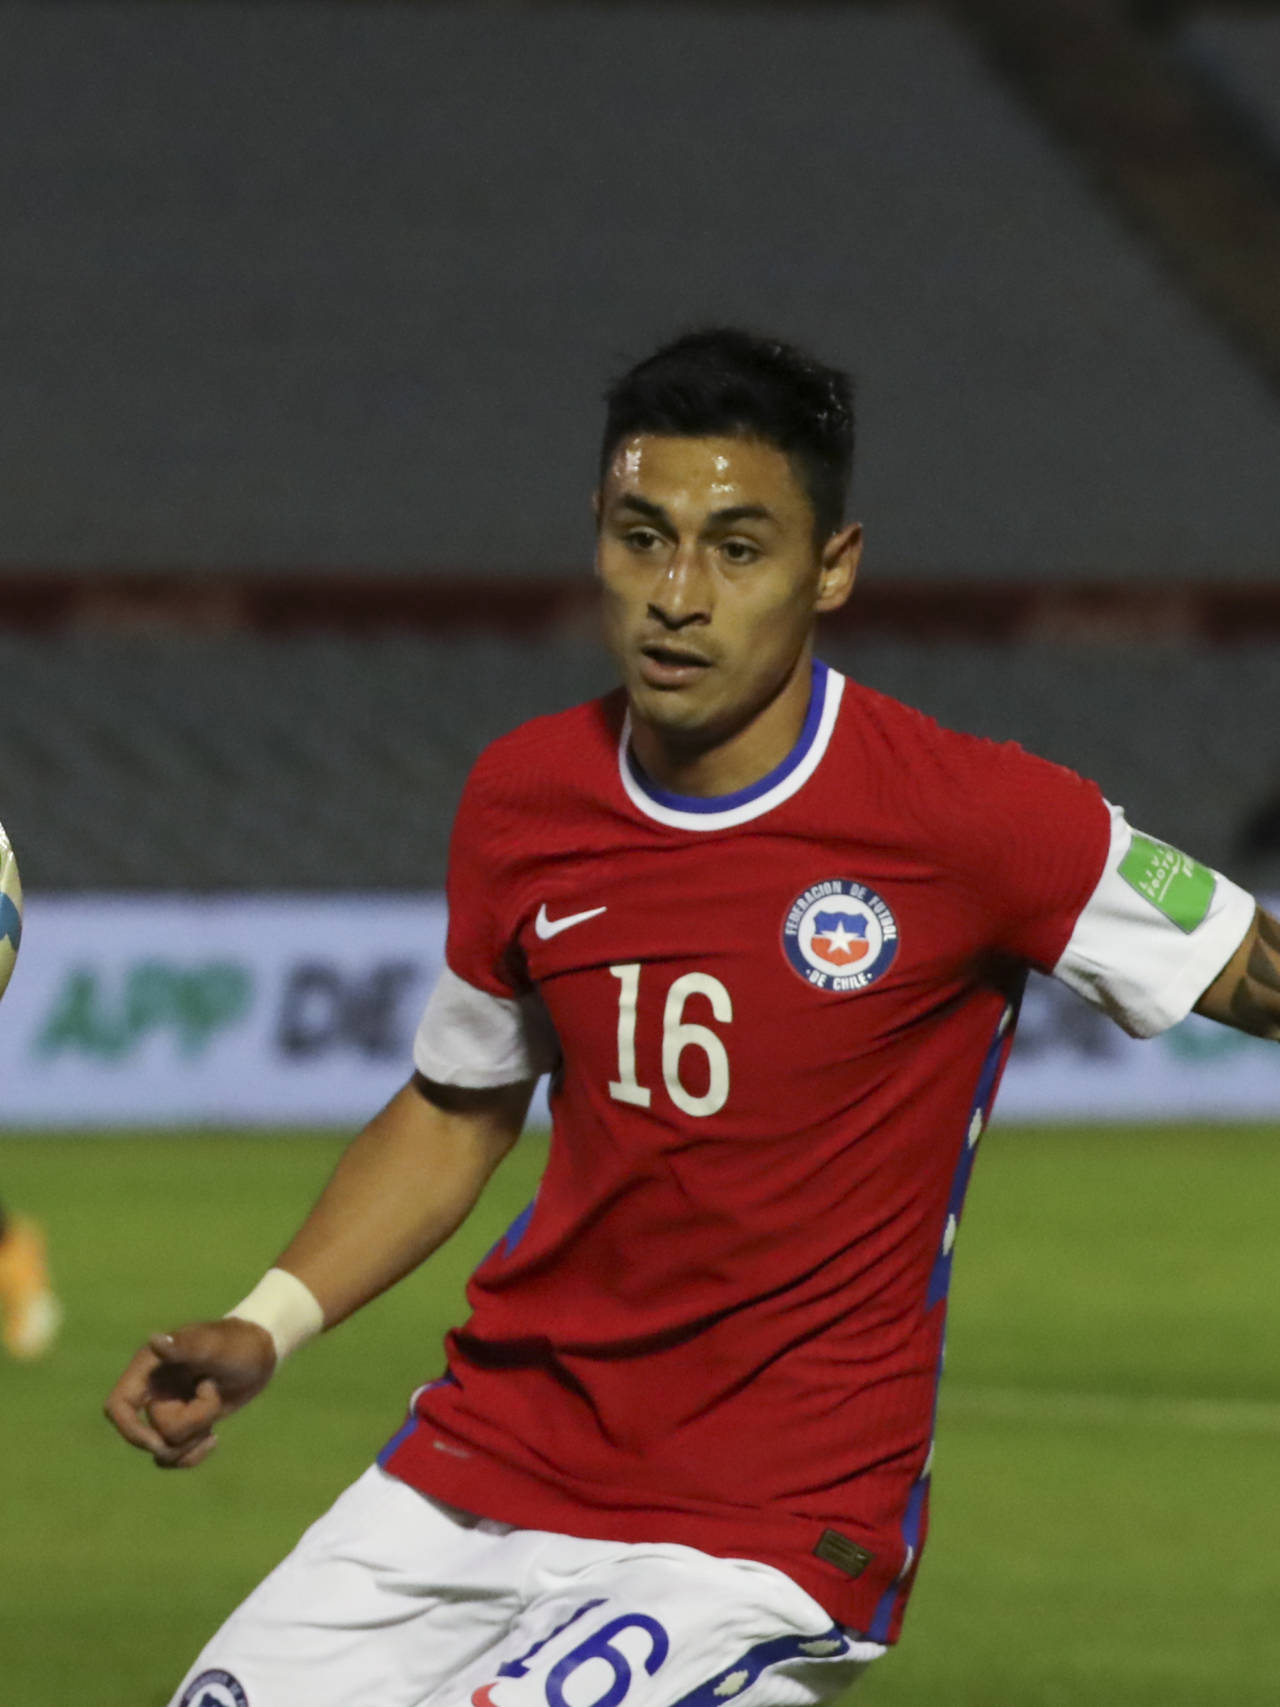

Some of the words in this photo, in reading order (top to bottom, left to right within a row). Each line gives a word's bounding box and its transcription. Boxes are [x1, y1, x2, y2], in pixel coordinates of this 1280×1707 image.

[785, 880, 842, 936] FEDERACION
[849, 882, 868, 900] DE
[867, 895, 898, 942] FUTBOL
[808, 969, 828, 988] DE
[832, 972, 870, 991] CHILE
[608, 963, 733, 1117] 16
